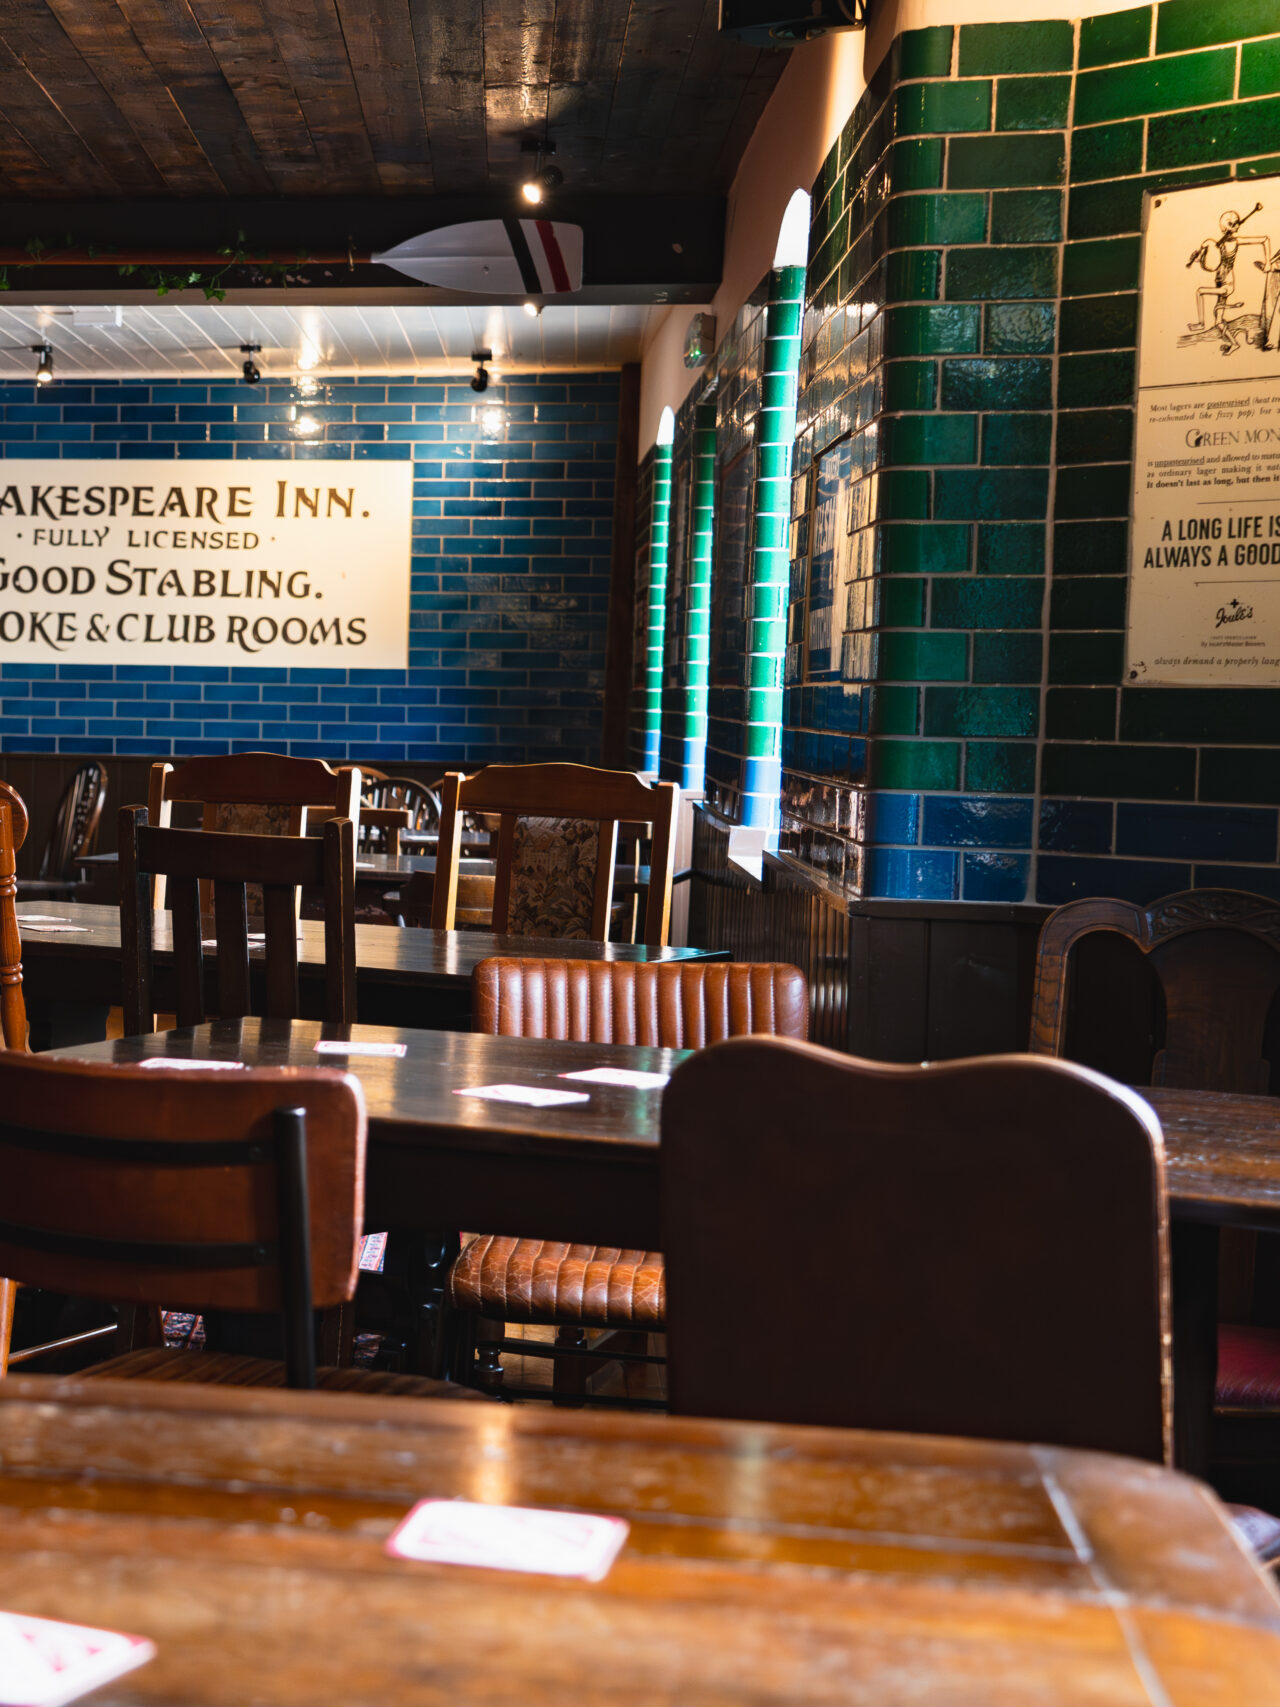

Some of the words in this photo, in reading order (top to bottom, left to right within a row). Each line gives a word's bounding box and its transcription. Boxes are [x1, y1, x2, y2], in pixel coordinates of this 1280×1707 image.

[1186, 429, 1240, 448] GREEN
[1154, 456, 1205, 468] unpasteurised
[1222, 453, 1250, 462] allowed
[1159, 469, 1192, 478] ordinary
[1197, 467, 1217, 476] lager
[1222, 466, 1251, 474] making
[1156, 480, 1183, 488] doesn't
[1214, 478, 1233, 487] long,
[276, 481, 370, 518] INN.
[33, 526, 110, 547] FULLY
[128, 530, 259, 549] LICENSED
[1161, 520, 1172, 541] A
[1178, 518, 1222, 540] LONG
[1228, 516, 1263, 538] LIFE
[1144, 545, 1212, 568] ALWAYS
[1217, 545, 1228, 566] A
[1235, 543, 1280, 565] GOOD
[106, 559, 322, 599] STABLING.
[116, 613, 215, 643] CLUB
[226, 615, 367, 654] ROOMS
[1154, 657, 1181, 667] always
[1183, 657, 1214, 665] demand
[1224, 657, 1258, 667] properly
